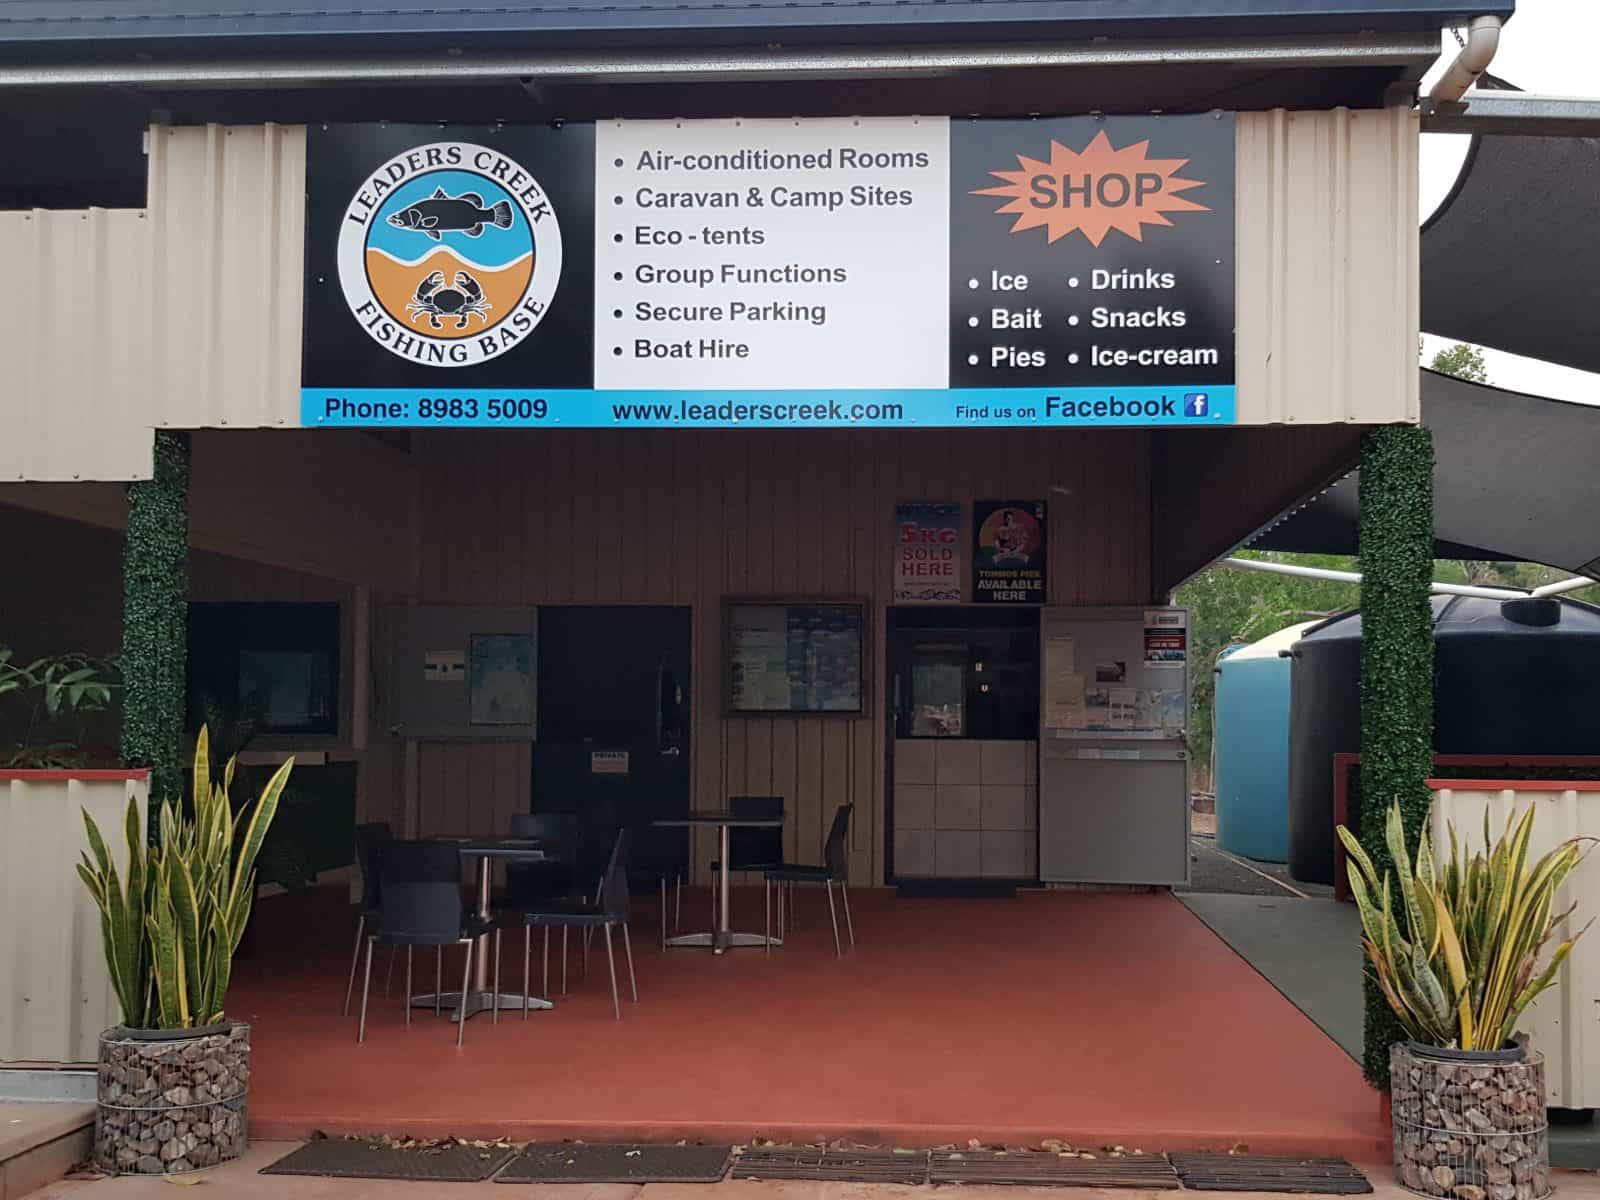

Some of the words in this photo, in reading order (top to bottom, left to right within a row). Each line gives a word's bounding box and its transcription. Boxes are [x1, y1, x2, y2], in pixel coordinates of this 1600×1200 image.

[636, 148, 832, 171] Air-conditioned
[839, 148, 929, 169] Rooms
[349, 146, 462, 225] LEADERS
[473, 151, 551, 224] CREEK
[1029, 172, 1163, 210] SHOP
[635, 187, 739, 208] Caravan
[746, 187, 764, 208] &
[770, 186, 844, 212] Camp
[850, 185, 913, 206] Sites
[635, 225, 683, 245] Eco
[702, 226, 765, 245] tents
[635, 264, 714, 289] Group
[721, 263, 847, 284] Functions
[991, 270, 1028, 291] Ice
[1092, 268, 1175, 290] Drinks
[635, 301, 723, 321] Secure
[730, 301, 826, 326] Parking
[991, 308, 1042, 329] Bait
[1091, 306, 1186, 328] Snacks
[355, 299, 469, 363] FISHING
[478, 296, 546, 356] BASE
[634, 339, 693, 358] Boat
[699, 339, 749, 358] Hire
[991, 346, 1046, 367] Pies
[1091, 345, 1218, 366] Ice-cream
[325, 398, 409, 418] Phone:
[418, 398, 479, 419] 8983
[487, 398, 548, 419] 5009
[612, 399, 903, 420] www.leaderscreek.com
[956, 405, 989, 419] Find
[993, 407, 1012, 418] us
[1016, 406, 1036, 418] on
[1046, 395, 1176, 418] Facebook
[902, 547, 953, 561] SOLD
[901, 561, 954, 577] HERE
[977, 579, 1042, 590] AVAILABLE
[993, 591, 1027, 601] HERE
